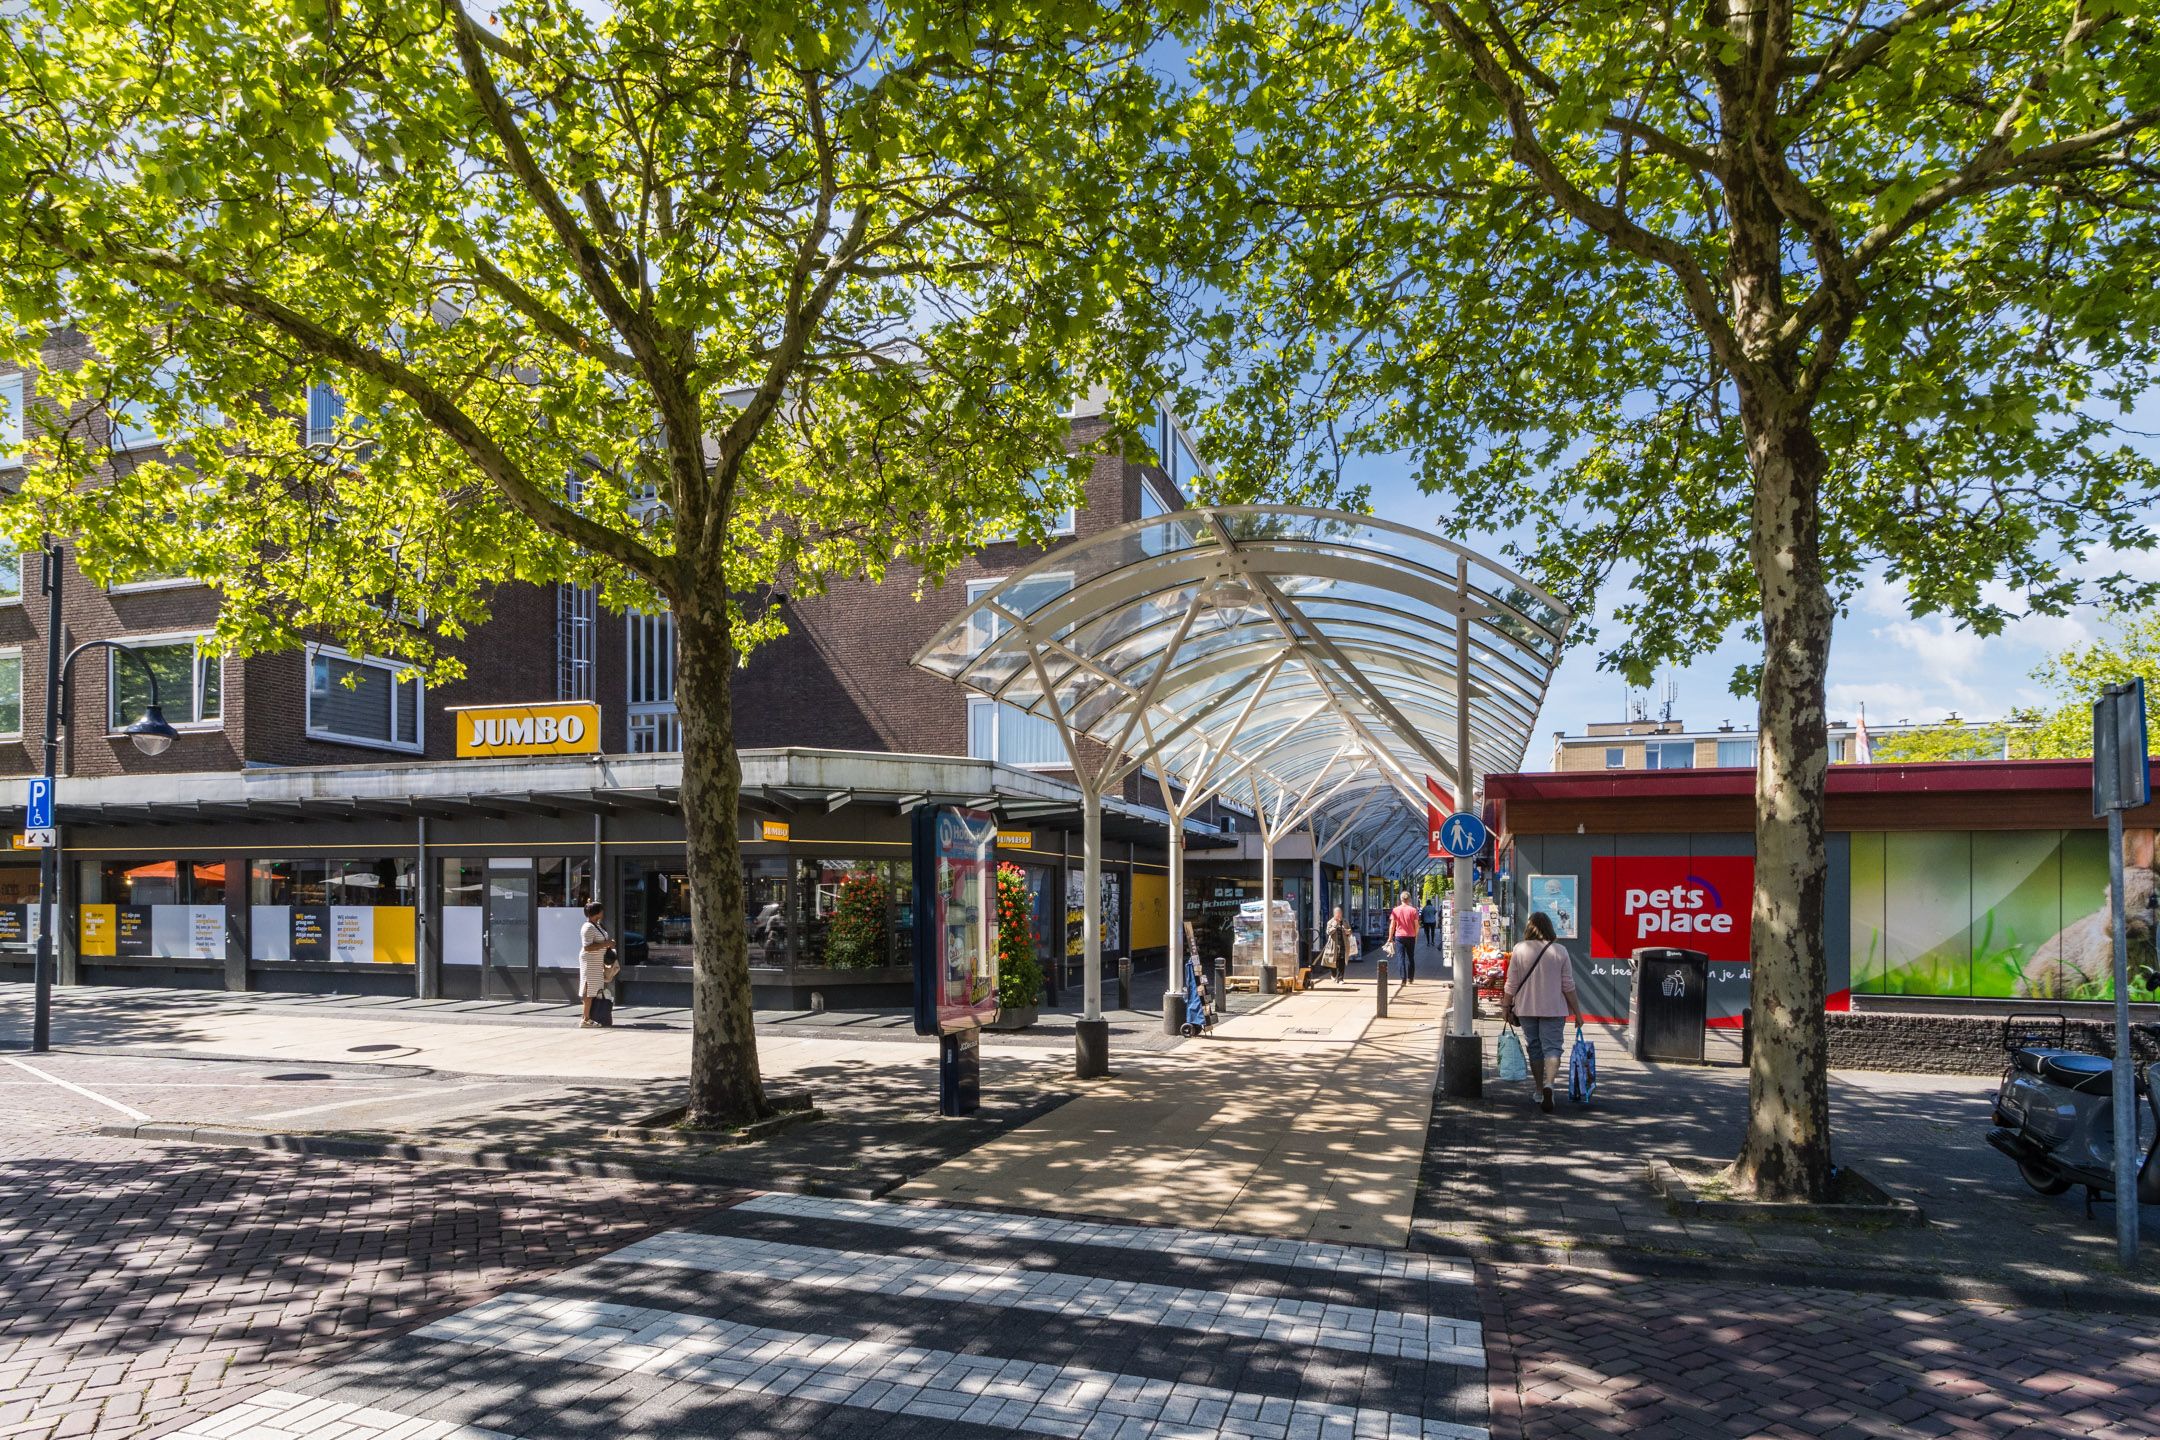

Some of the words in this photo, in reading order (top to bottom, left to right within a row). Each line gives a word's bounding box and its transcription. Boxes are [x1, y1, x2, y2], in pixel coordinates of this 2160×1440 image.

[470, 715, 585, 747] JUMBO
[33, 782, 46, 807] P
[763, 826, 789, 837] JUMBO
[1186, 902, 1201, 910] De
[1624, 885, 1704, 915] pets
[1637, 909, 1733, 939] place
[1591, 964, 1607, 976] de
[1611, 964, 1632, 976] bes
[1719, 969, 1735, 983] je
[1739, 967, 1751, 979] di
